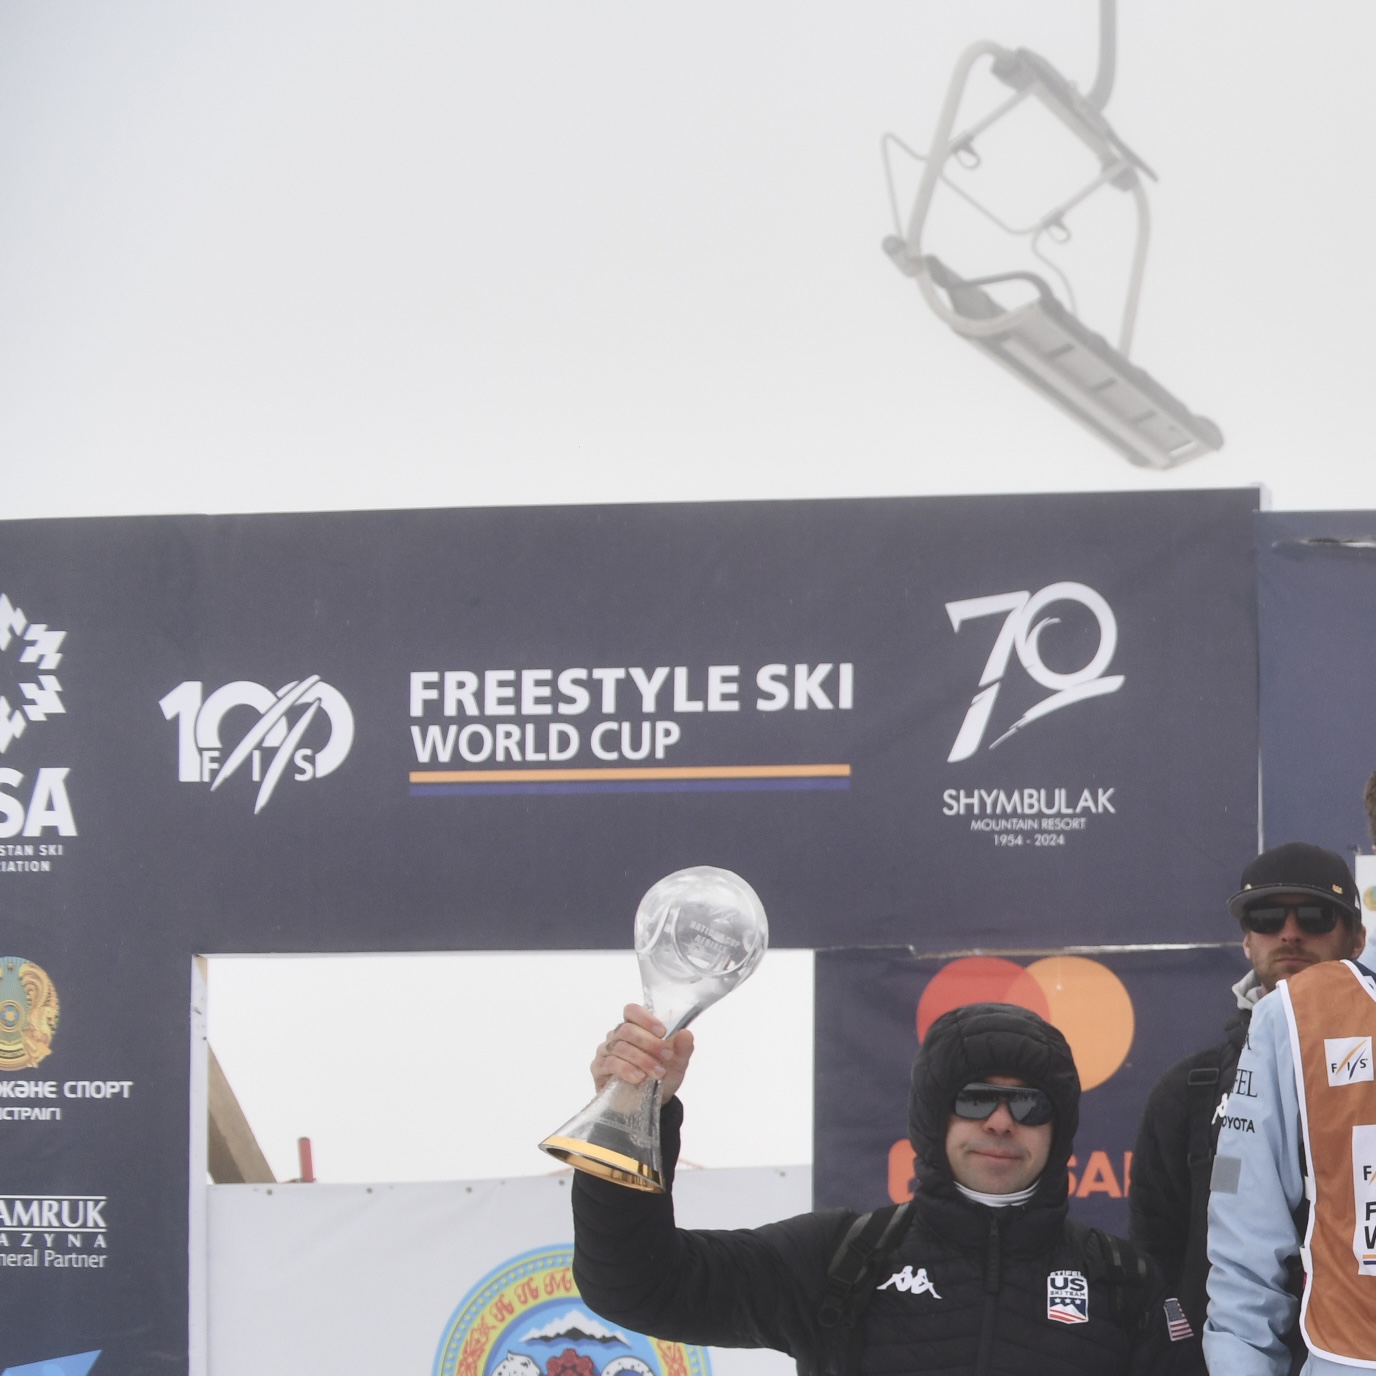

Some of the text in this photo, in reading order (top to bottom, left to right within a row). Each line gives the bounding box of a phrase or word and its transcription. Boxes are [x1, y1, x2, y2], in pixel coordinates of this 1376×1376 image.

[409, 662, 854, 717] FREESTYLE SKI
[410, 720, 681, 763] WORLD CUP
[943, 787, 1115, 815] SHYMBULAK
[970, 817, 1086, 831] MOUNTAIN RESORT
[994, 834, 1021, 846] 1954
[1034, 834, 1065, 846] 2024
[39, 844, 63, 856] SKI
[0, 860, 51, 872] IATION
[1331, 1058, 1367, 1074] FIS
[63, 1080, 134, 1099] СПОРТ
[44, 1250, 107, 1268] Partner
[1050, 1277, 1085, 1291] US
